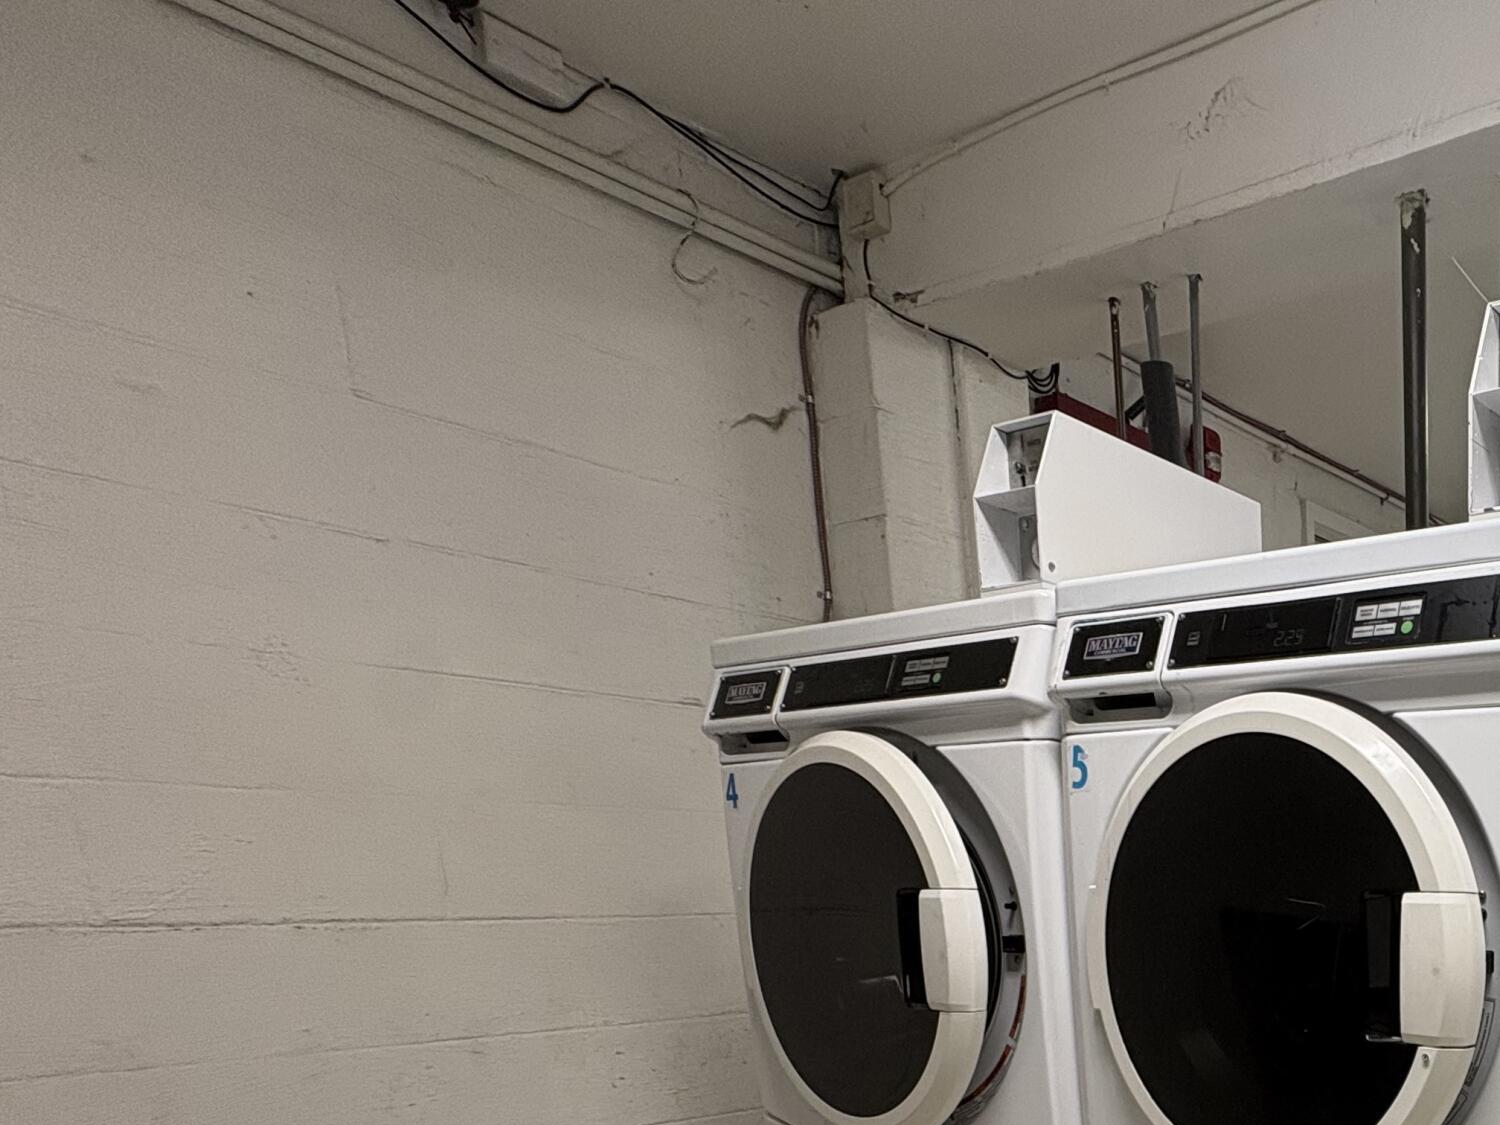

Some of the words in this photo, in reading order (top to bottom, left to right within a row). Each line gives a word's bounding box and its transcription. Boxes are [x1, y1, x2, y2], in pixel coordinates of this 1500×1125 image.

[1088, 635, 1138, 652] MAYTAG
[1072, 745, 1089, 789] 5
[726, 773, 739, 809] 4
